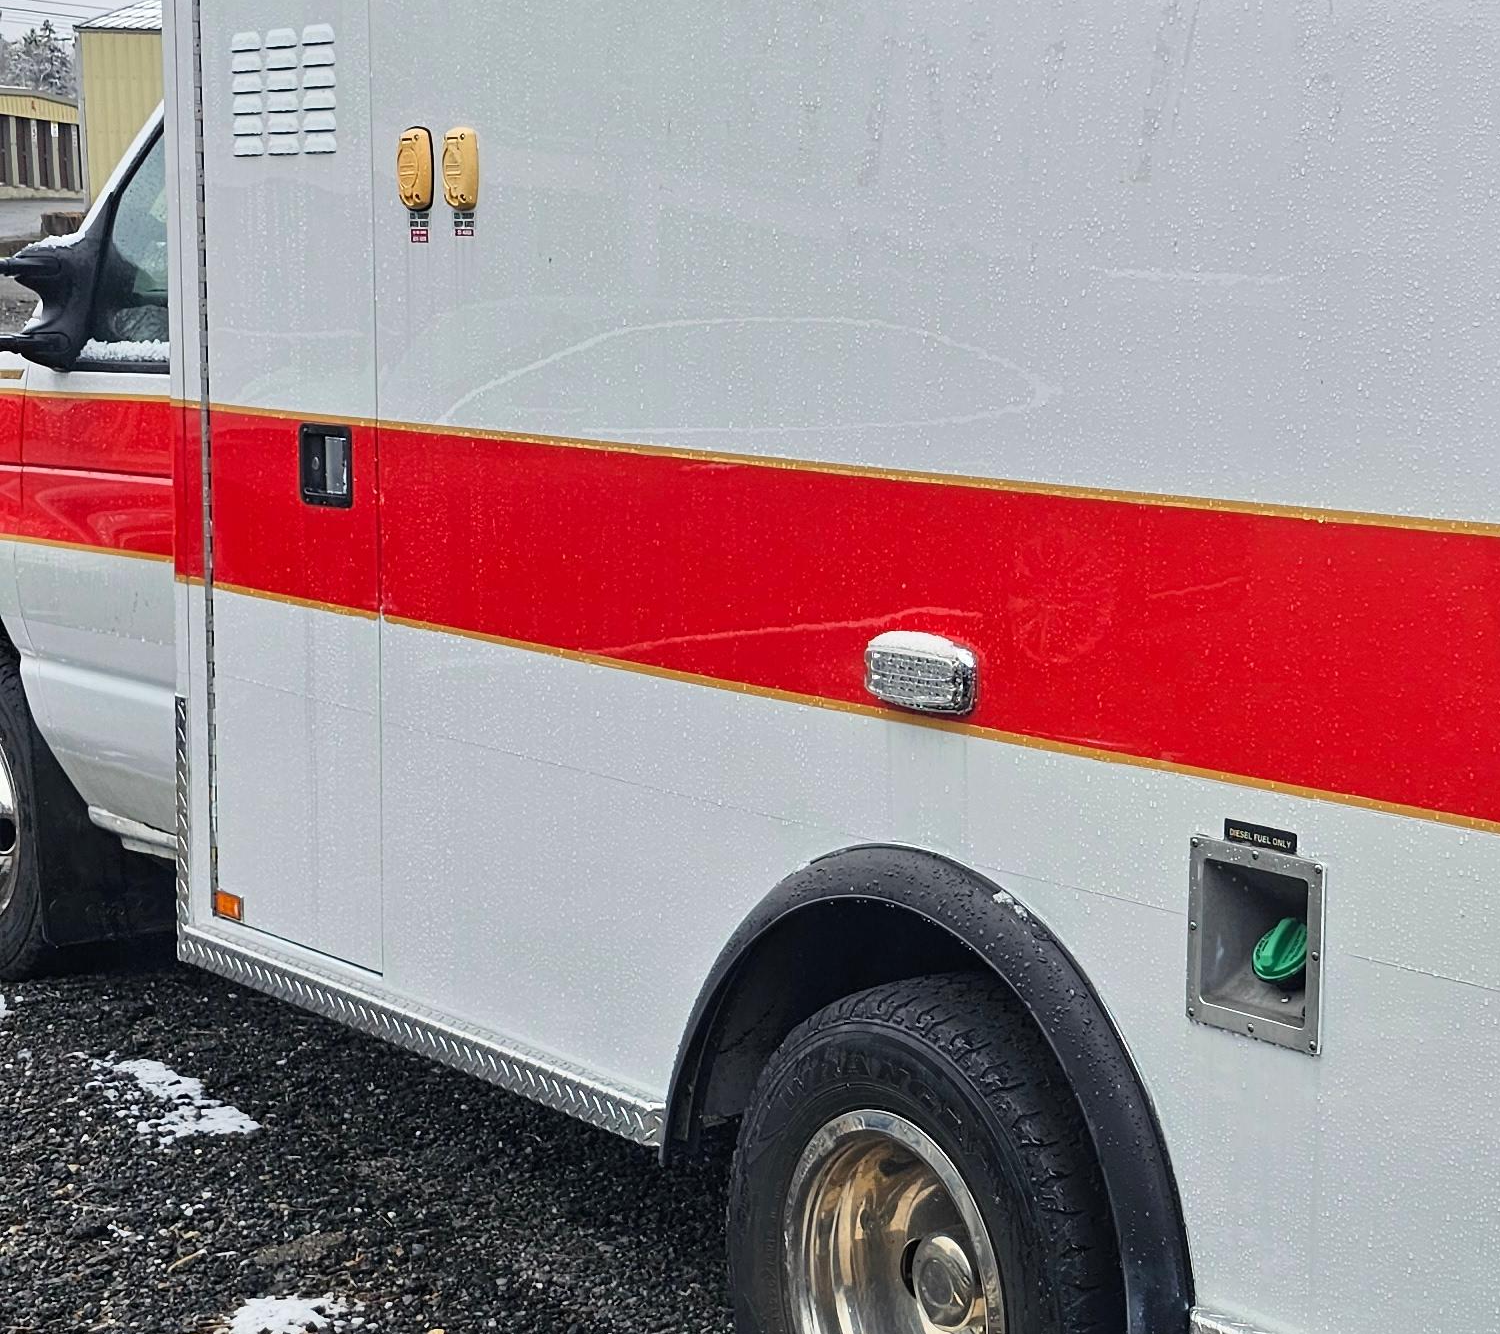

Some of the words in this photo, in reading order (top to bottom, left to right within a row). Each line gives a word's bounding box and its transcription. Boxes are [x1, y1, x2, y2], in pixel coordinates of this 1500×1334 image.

[1229, 827, 1253, 841] DIESEL
[1253, 833, 1272, 845] FUEL
[1272, 837, 1292, 849] ONLY
